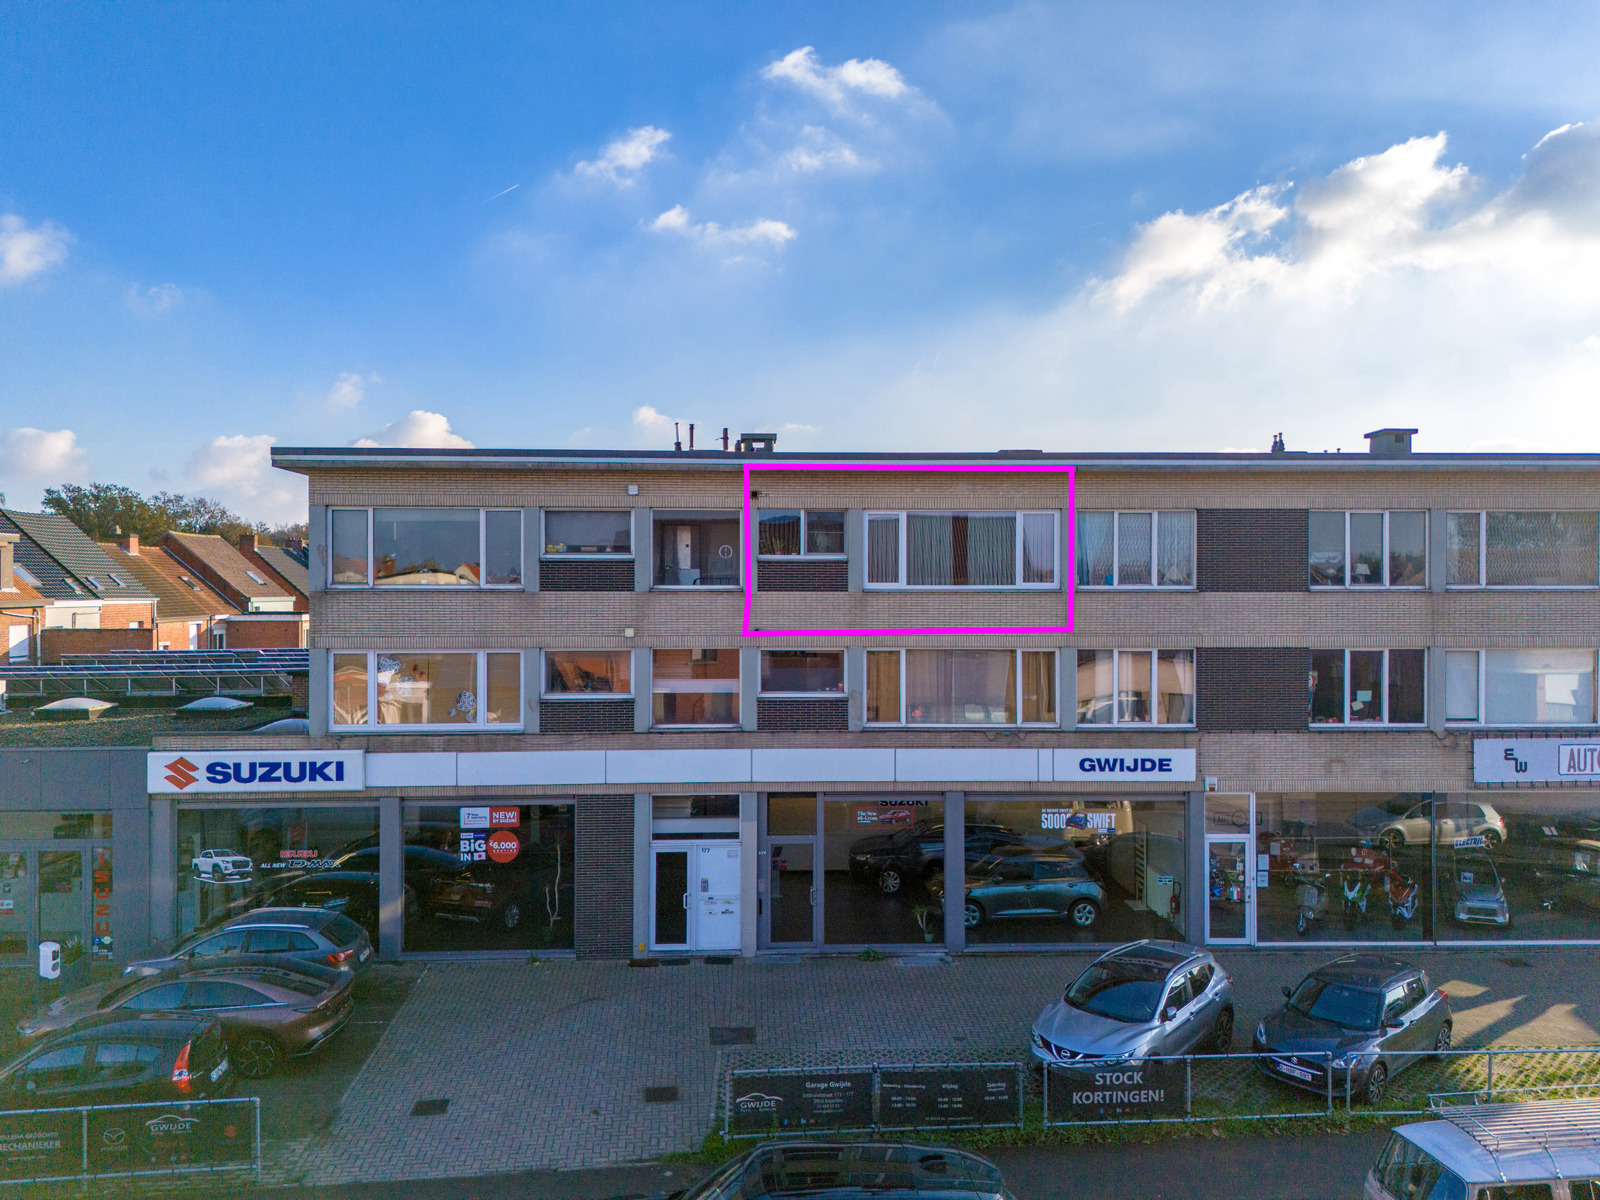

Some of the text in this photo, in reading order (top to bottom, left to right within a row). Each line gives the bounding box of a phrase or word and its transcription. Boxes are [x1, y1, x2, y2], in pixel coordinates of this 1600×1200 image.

[1079, 757, 1172, 773] GWIJDE
[1567, 748, 1600, 773] AUT
[206, 760, 345, 784] SUZUKI
[492, 811, 517, 819] NEW!
[1086, 813, 1116, 828] SWIFT
[280, 849, 318, 858] ISUZU
[460, 853, 471, 861] IN
[1094, 1071, 1144, 1085] STOCK
[805, 1080, 851, 1089] Garage Gwijde
[1072, 1089, 1164, 1105] KORTINGEN!
[740, 1100, 776, 1109] GWIJDE
[151, 1122, 191, 1131] GWIJDE
